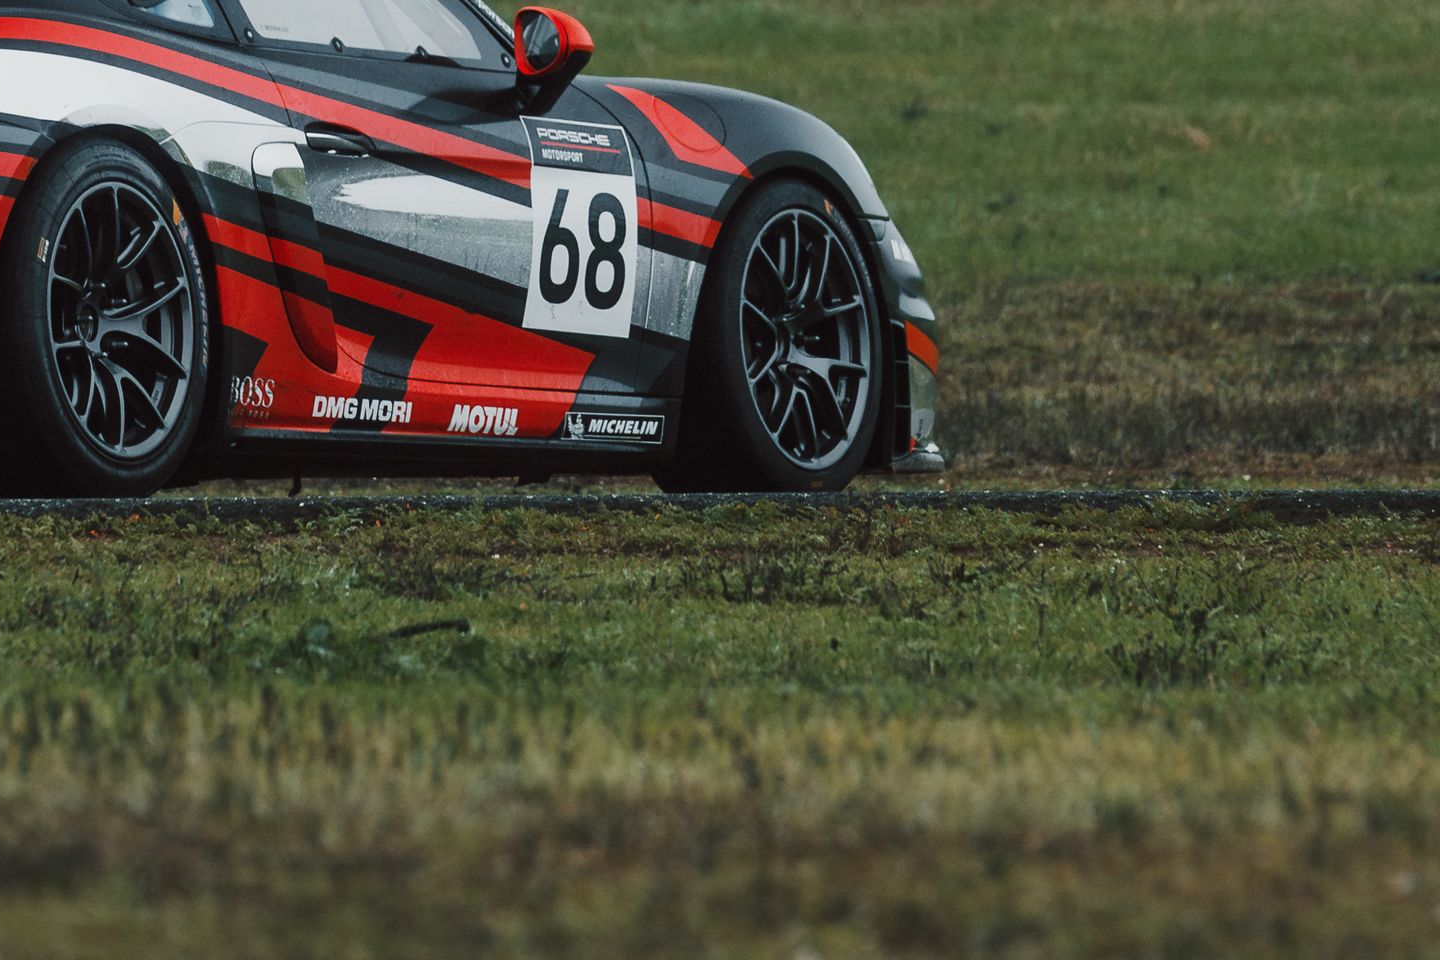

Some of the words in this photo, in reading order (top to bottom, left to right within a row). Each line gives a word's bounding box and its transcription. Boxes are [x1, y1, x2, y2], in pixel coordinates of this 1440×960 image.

[536, 127, 611, 147] PORSCHE
[541, 148, 584, 164] MOTORSPORT
[539, 188, 627, 310] 68
[230, 375, 275, 408] BOSS
[312, 395, 359, 420] DMG
[359, 398, 413, 424] MORI
[447, 404, 519, 436] MOTUL
[587, 418, 659, 436] MICHELIN
